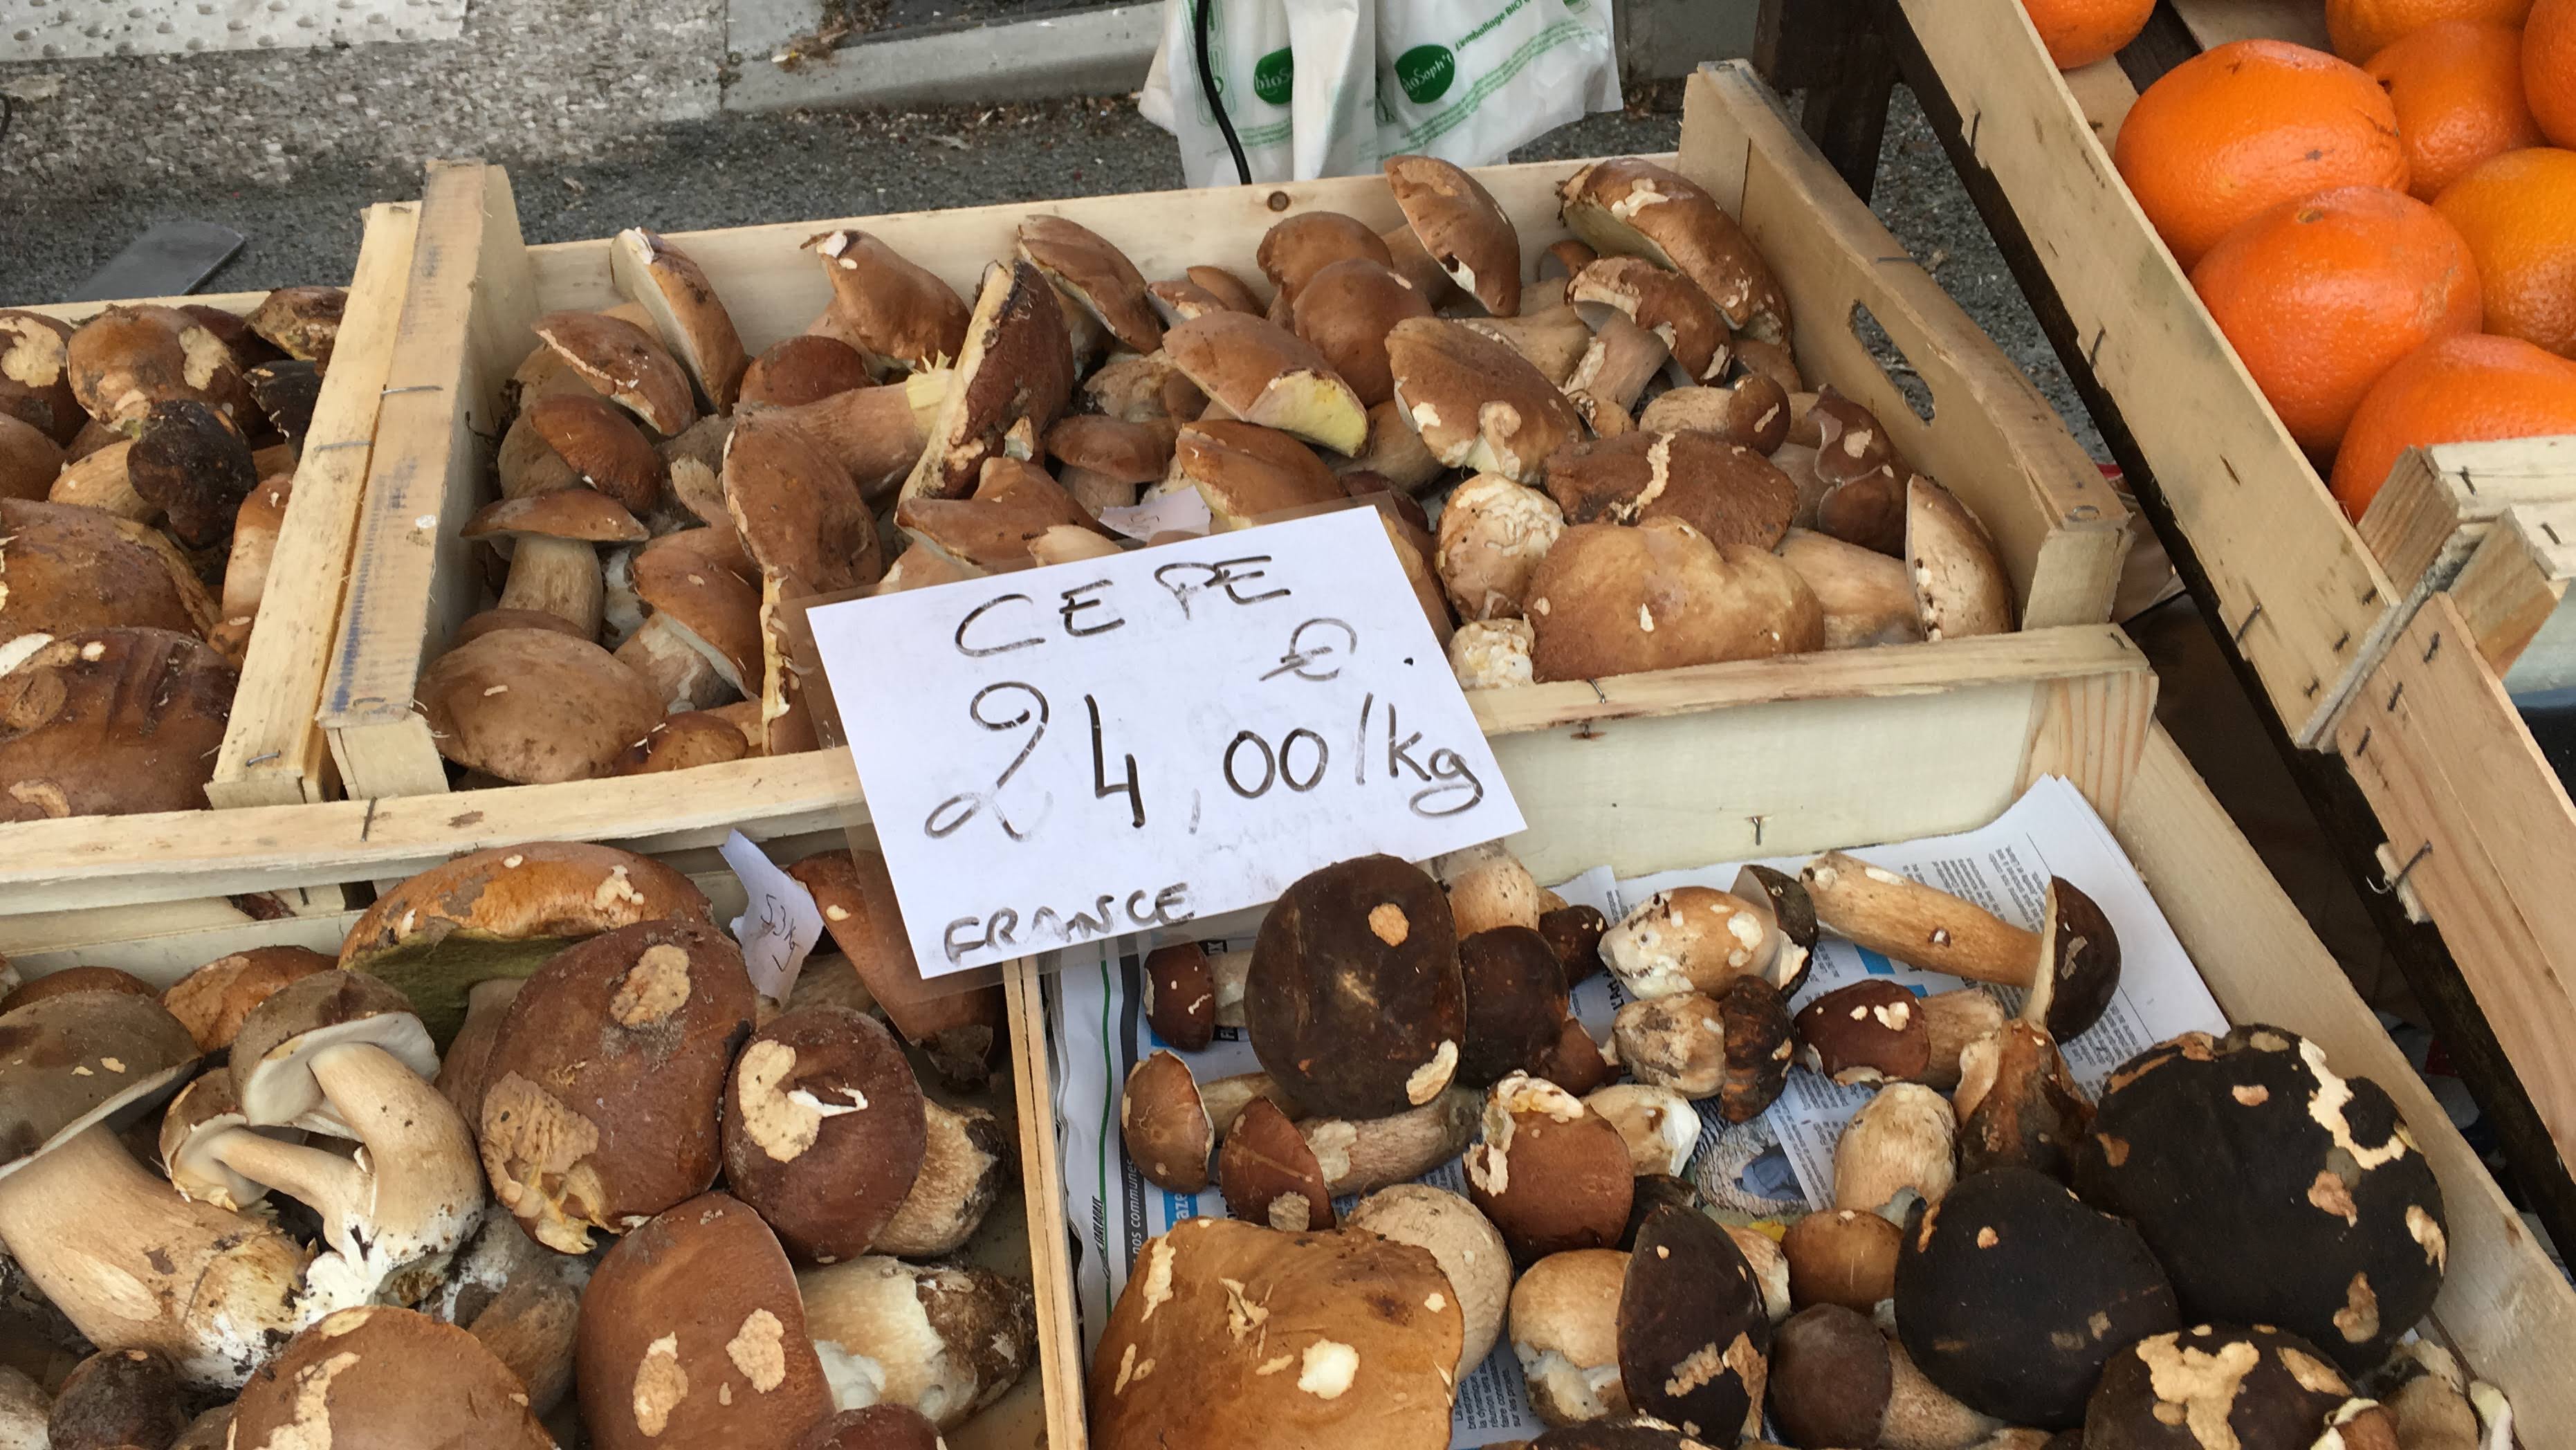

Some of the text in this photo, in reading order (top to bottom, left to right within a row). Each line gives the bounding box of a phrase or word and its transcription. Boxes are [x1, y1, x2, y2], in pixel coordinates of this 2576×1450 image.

[1255, 68, 1293, 91] bioS
[942, 882, 1195, 965] FRANCE
[1126, 1159, 1141, 1228] communes
[1130, 1231, 1142, 1254] nos
